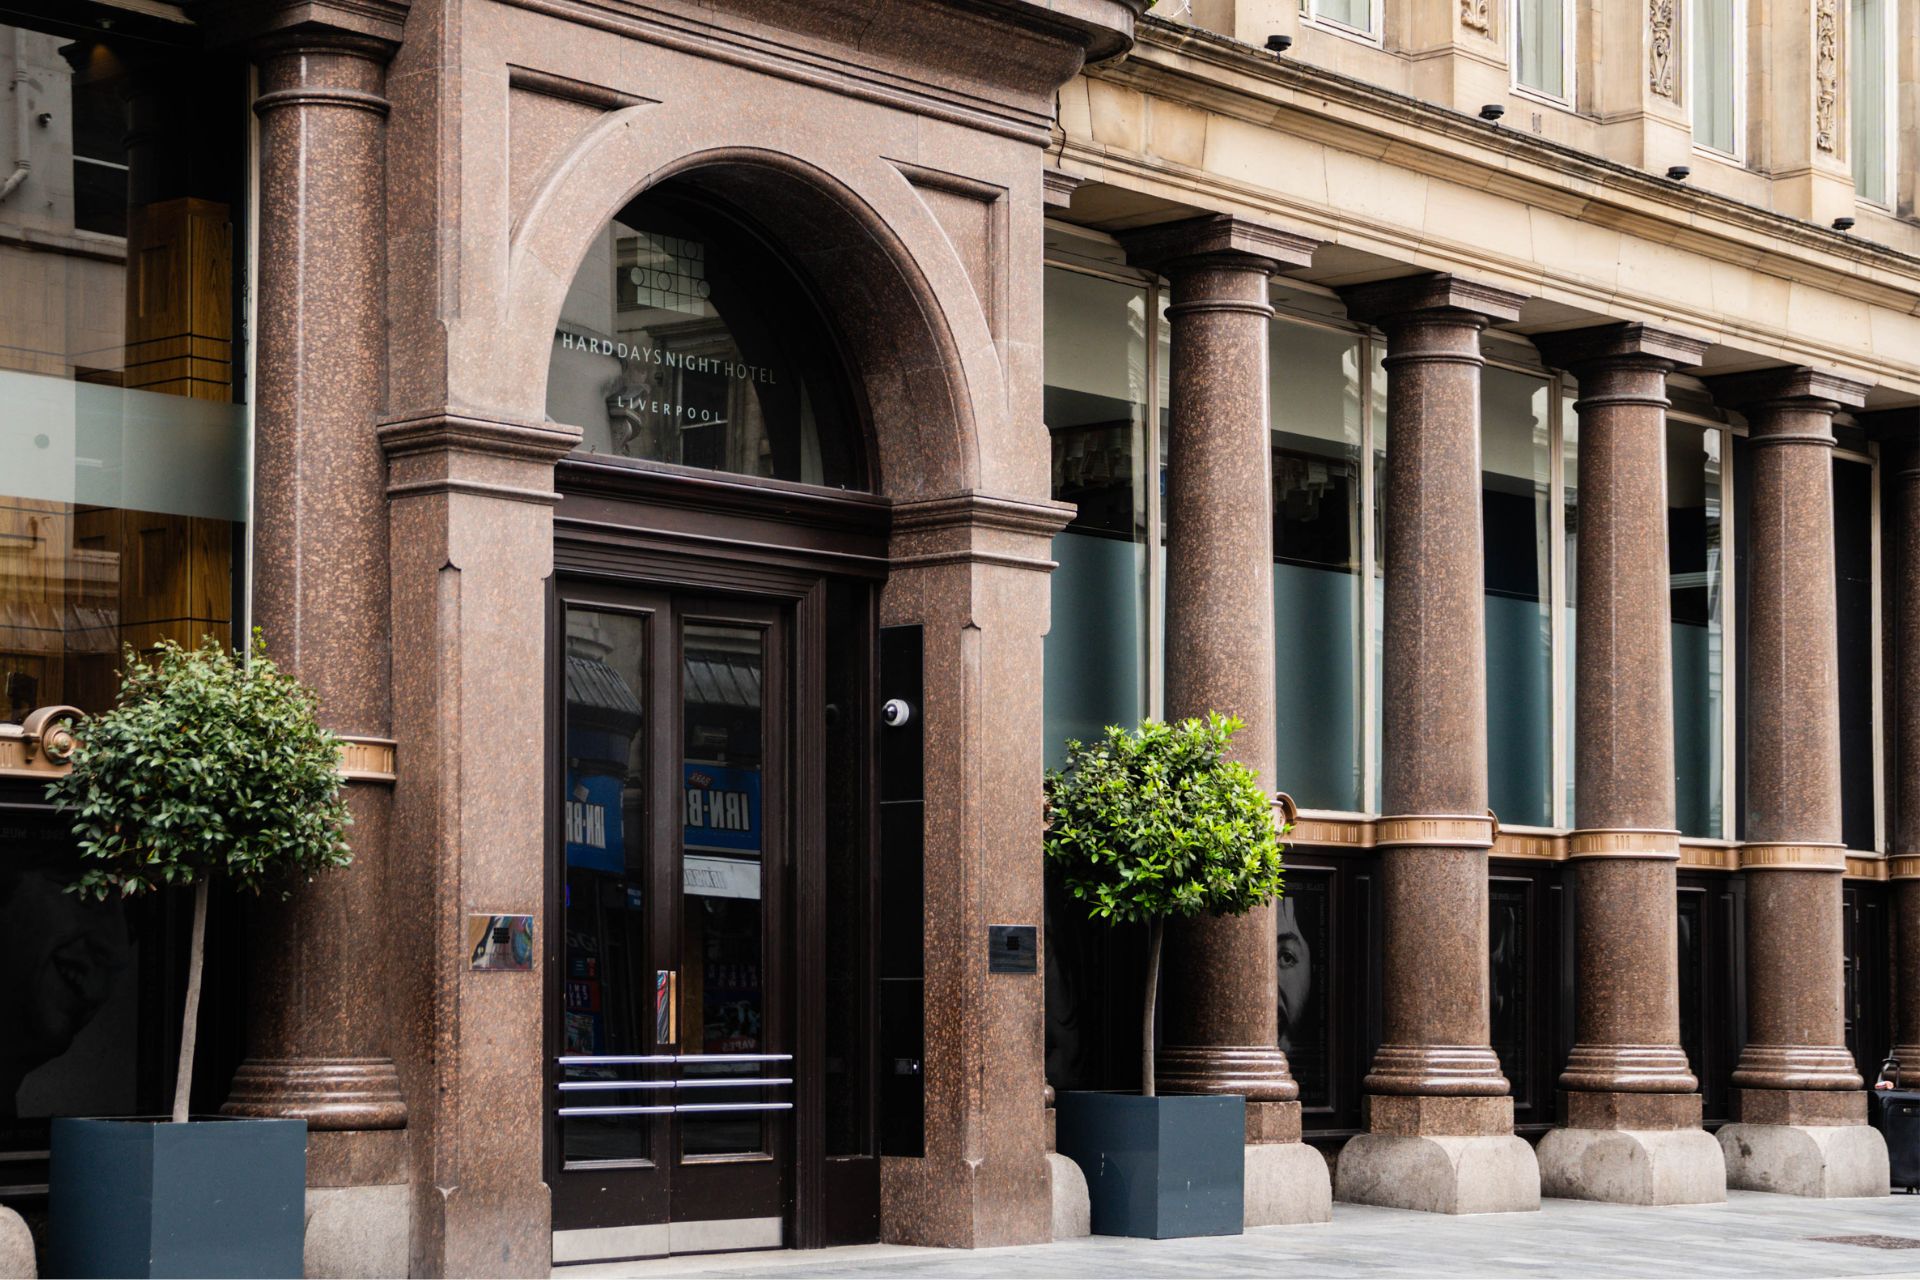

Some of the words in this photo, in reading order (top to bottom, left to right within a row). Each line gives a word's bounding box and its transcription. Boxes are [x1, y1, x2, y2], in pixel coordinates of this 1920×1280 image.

[563, 333, 613, 356] HARD
[617, 342, 662, 365] DAYS
[665, 351, 721, 375] NIGHT
[724, 361, 777, 385] HOTEL
[618, 395, 722, 424] LIVERPOOL
